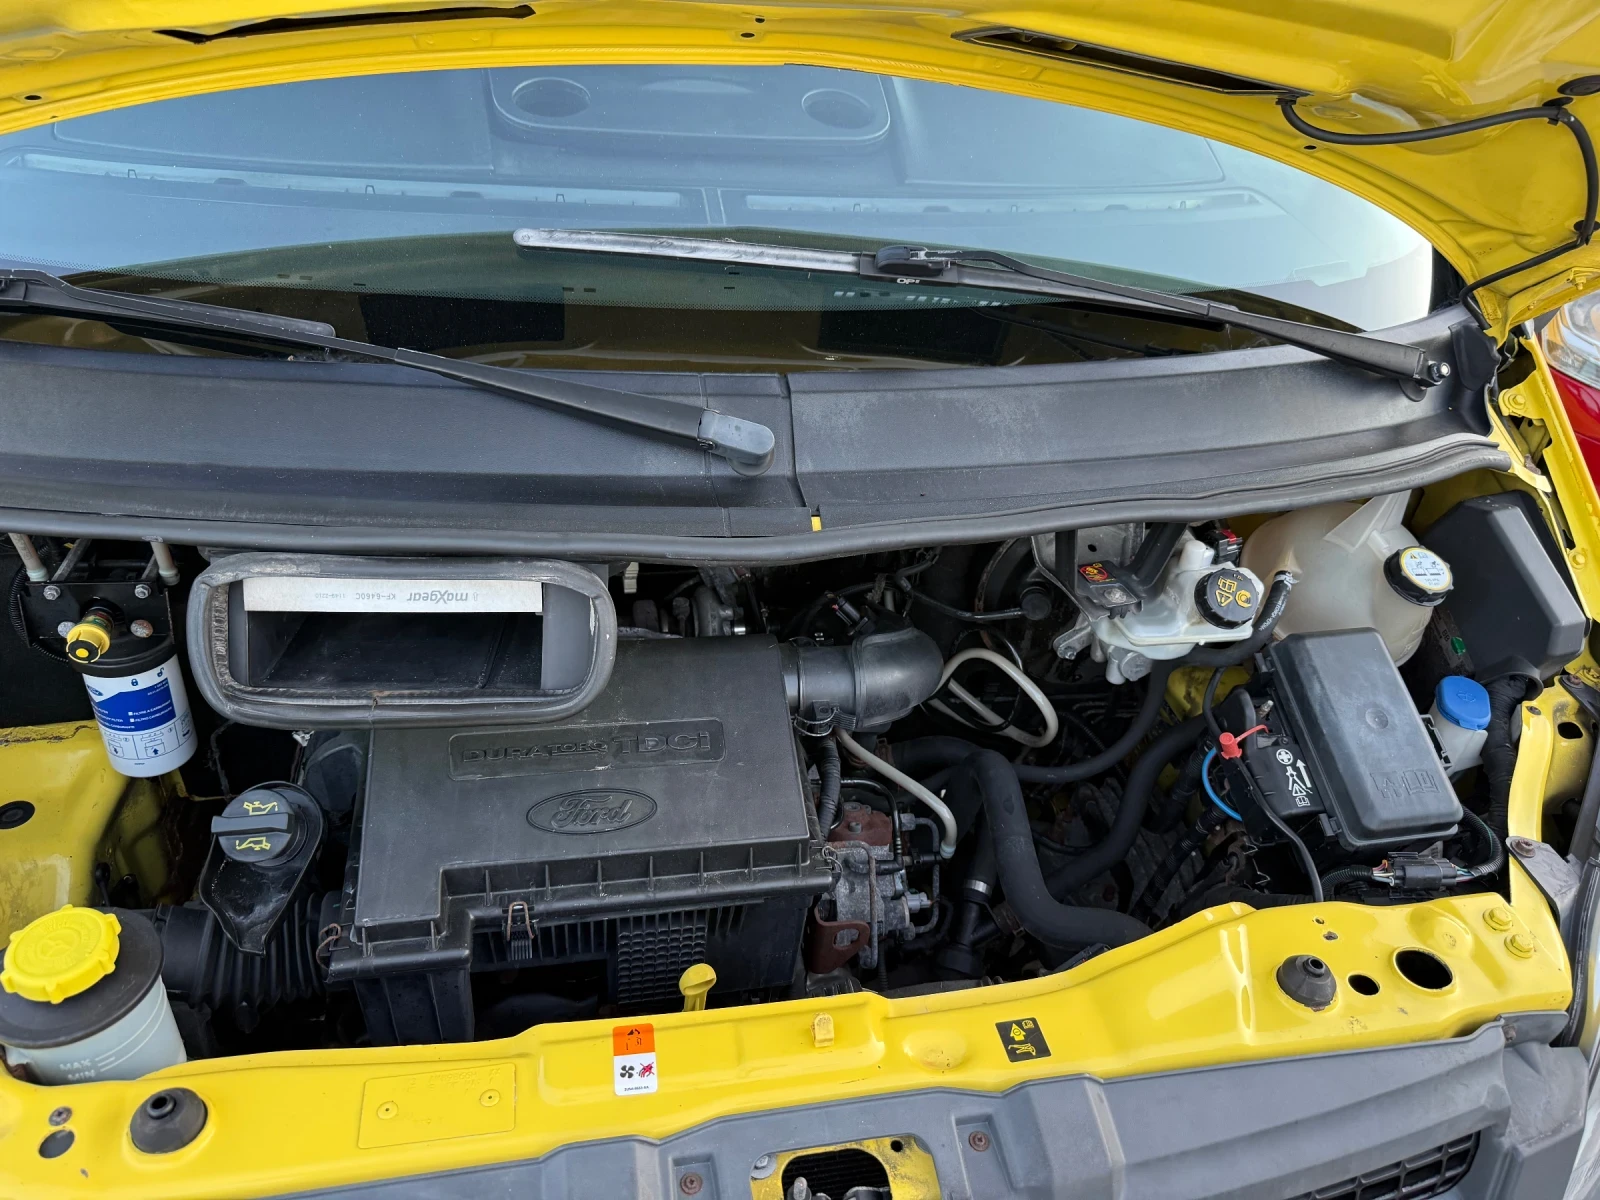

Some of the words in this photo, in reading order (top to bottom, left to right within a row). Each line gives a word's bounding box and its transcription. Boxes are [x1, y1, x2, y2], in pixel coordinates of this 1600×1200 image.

[550, 795, 633, 829] Ford
[59, 1059, 91, 1070] MAX
[68, 1070, 95, 1080] MIN
